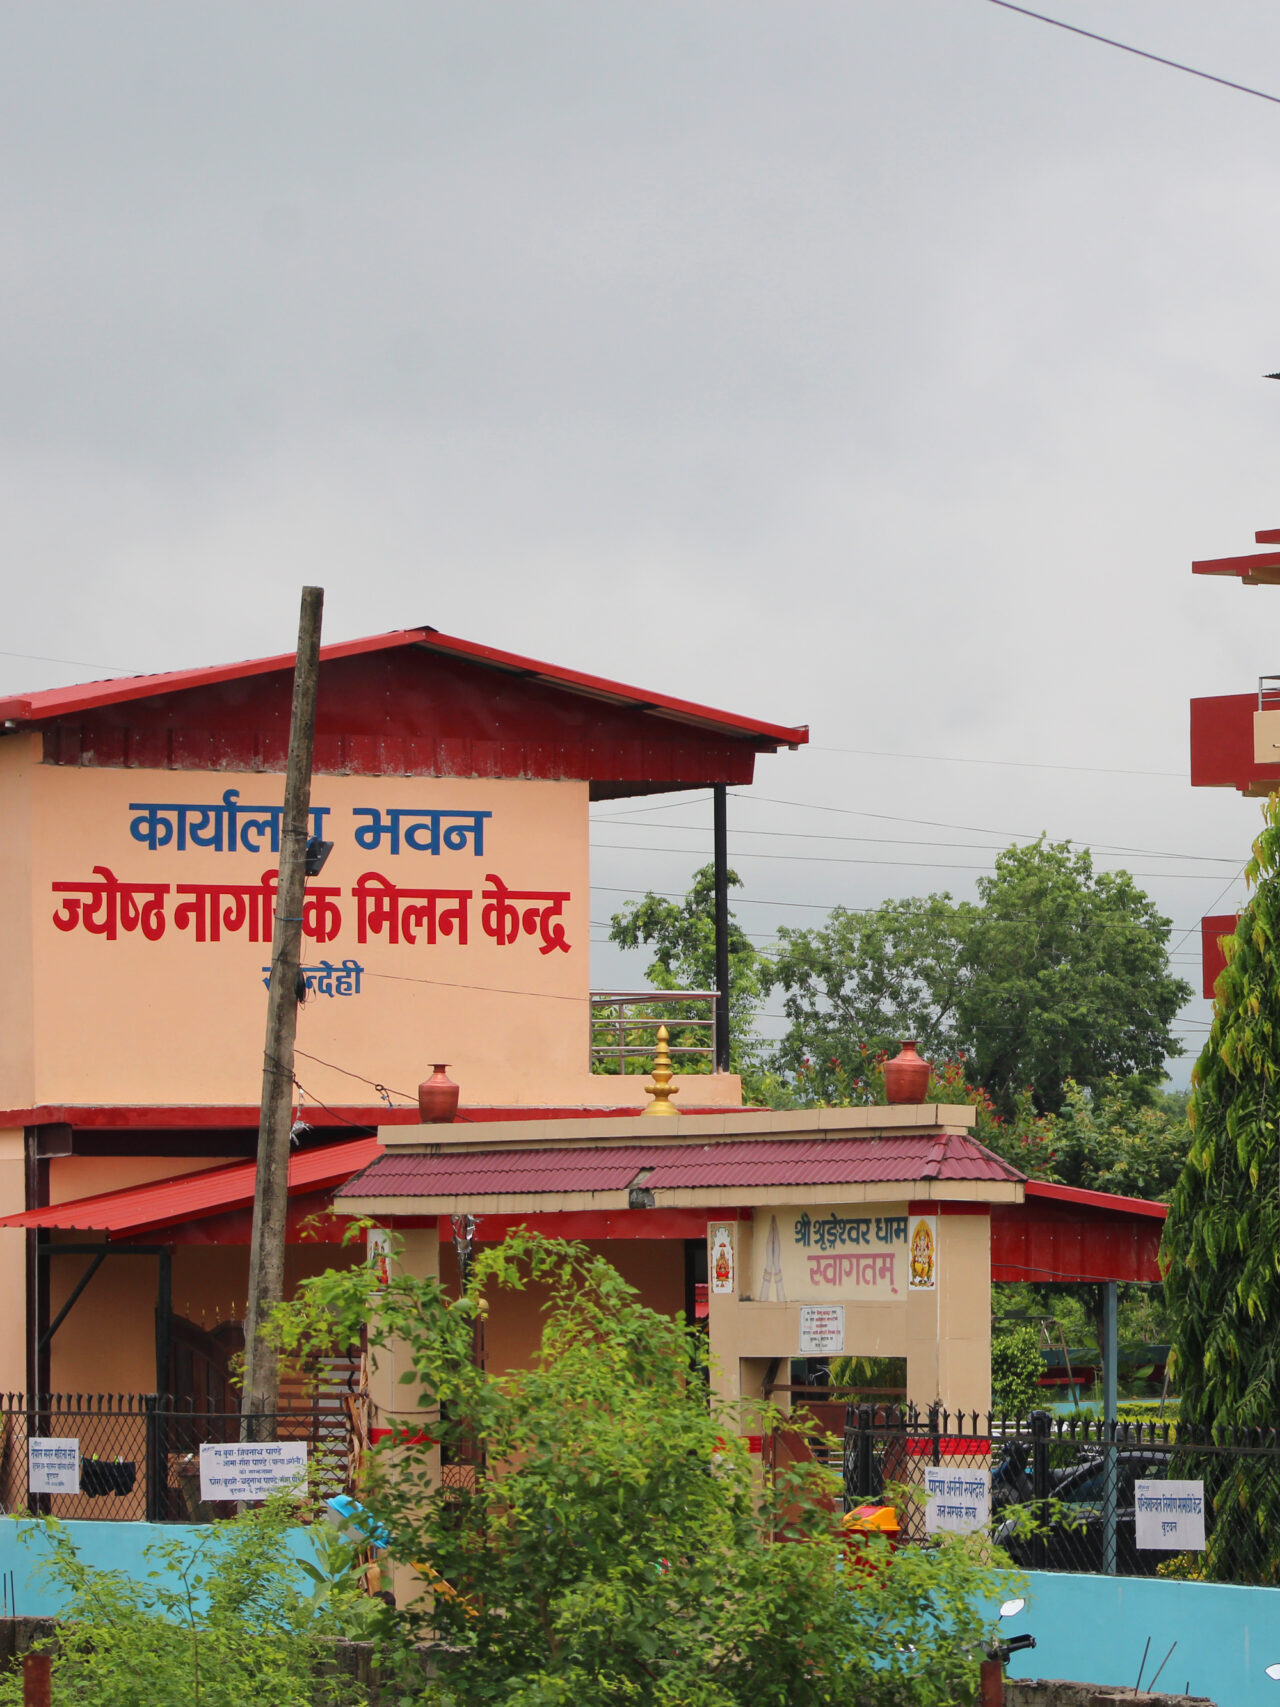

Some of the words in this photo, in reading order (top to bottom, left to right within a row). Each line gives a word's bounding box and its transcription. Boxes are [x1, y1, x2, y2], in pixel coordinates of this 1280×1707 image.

[352, 806, 493, 857] भवन
[52, 865, 171, 941] ज्येष्ठ
[352, 871, 473, 945] मिलन
[481, 873, 573, 955] केन्द्र
[795, 1212, 811, 1247] श्री
[874, 1216, 909, 1244] धाम
[807, 1252, 899, 1294] स्वागतम्
